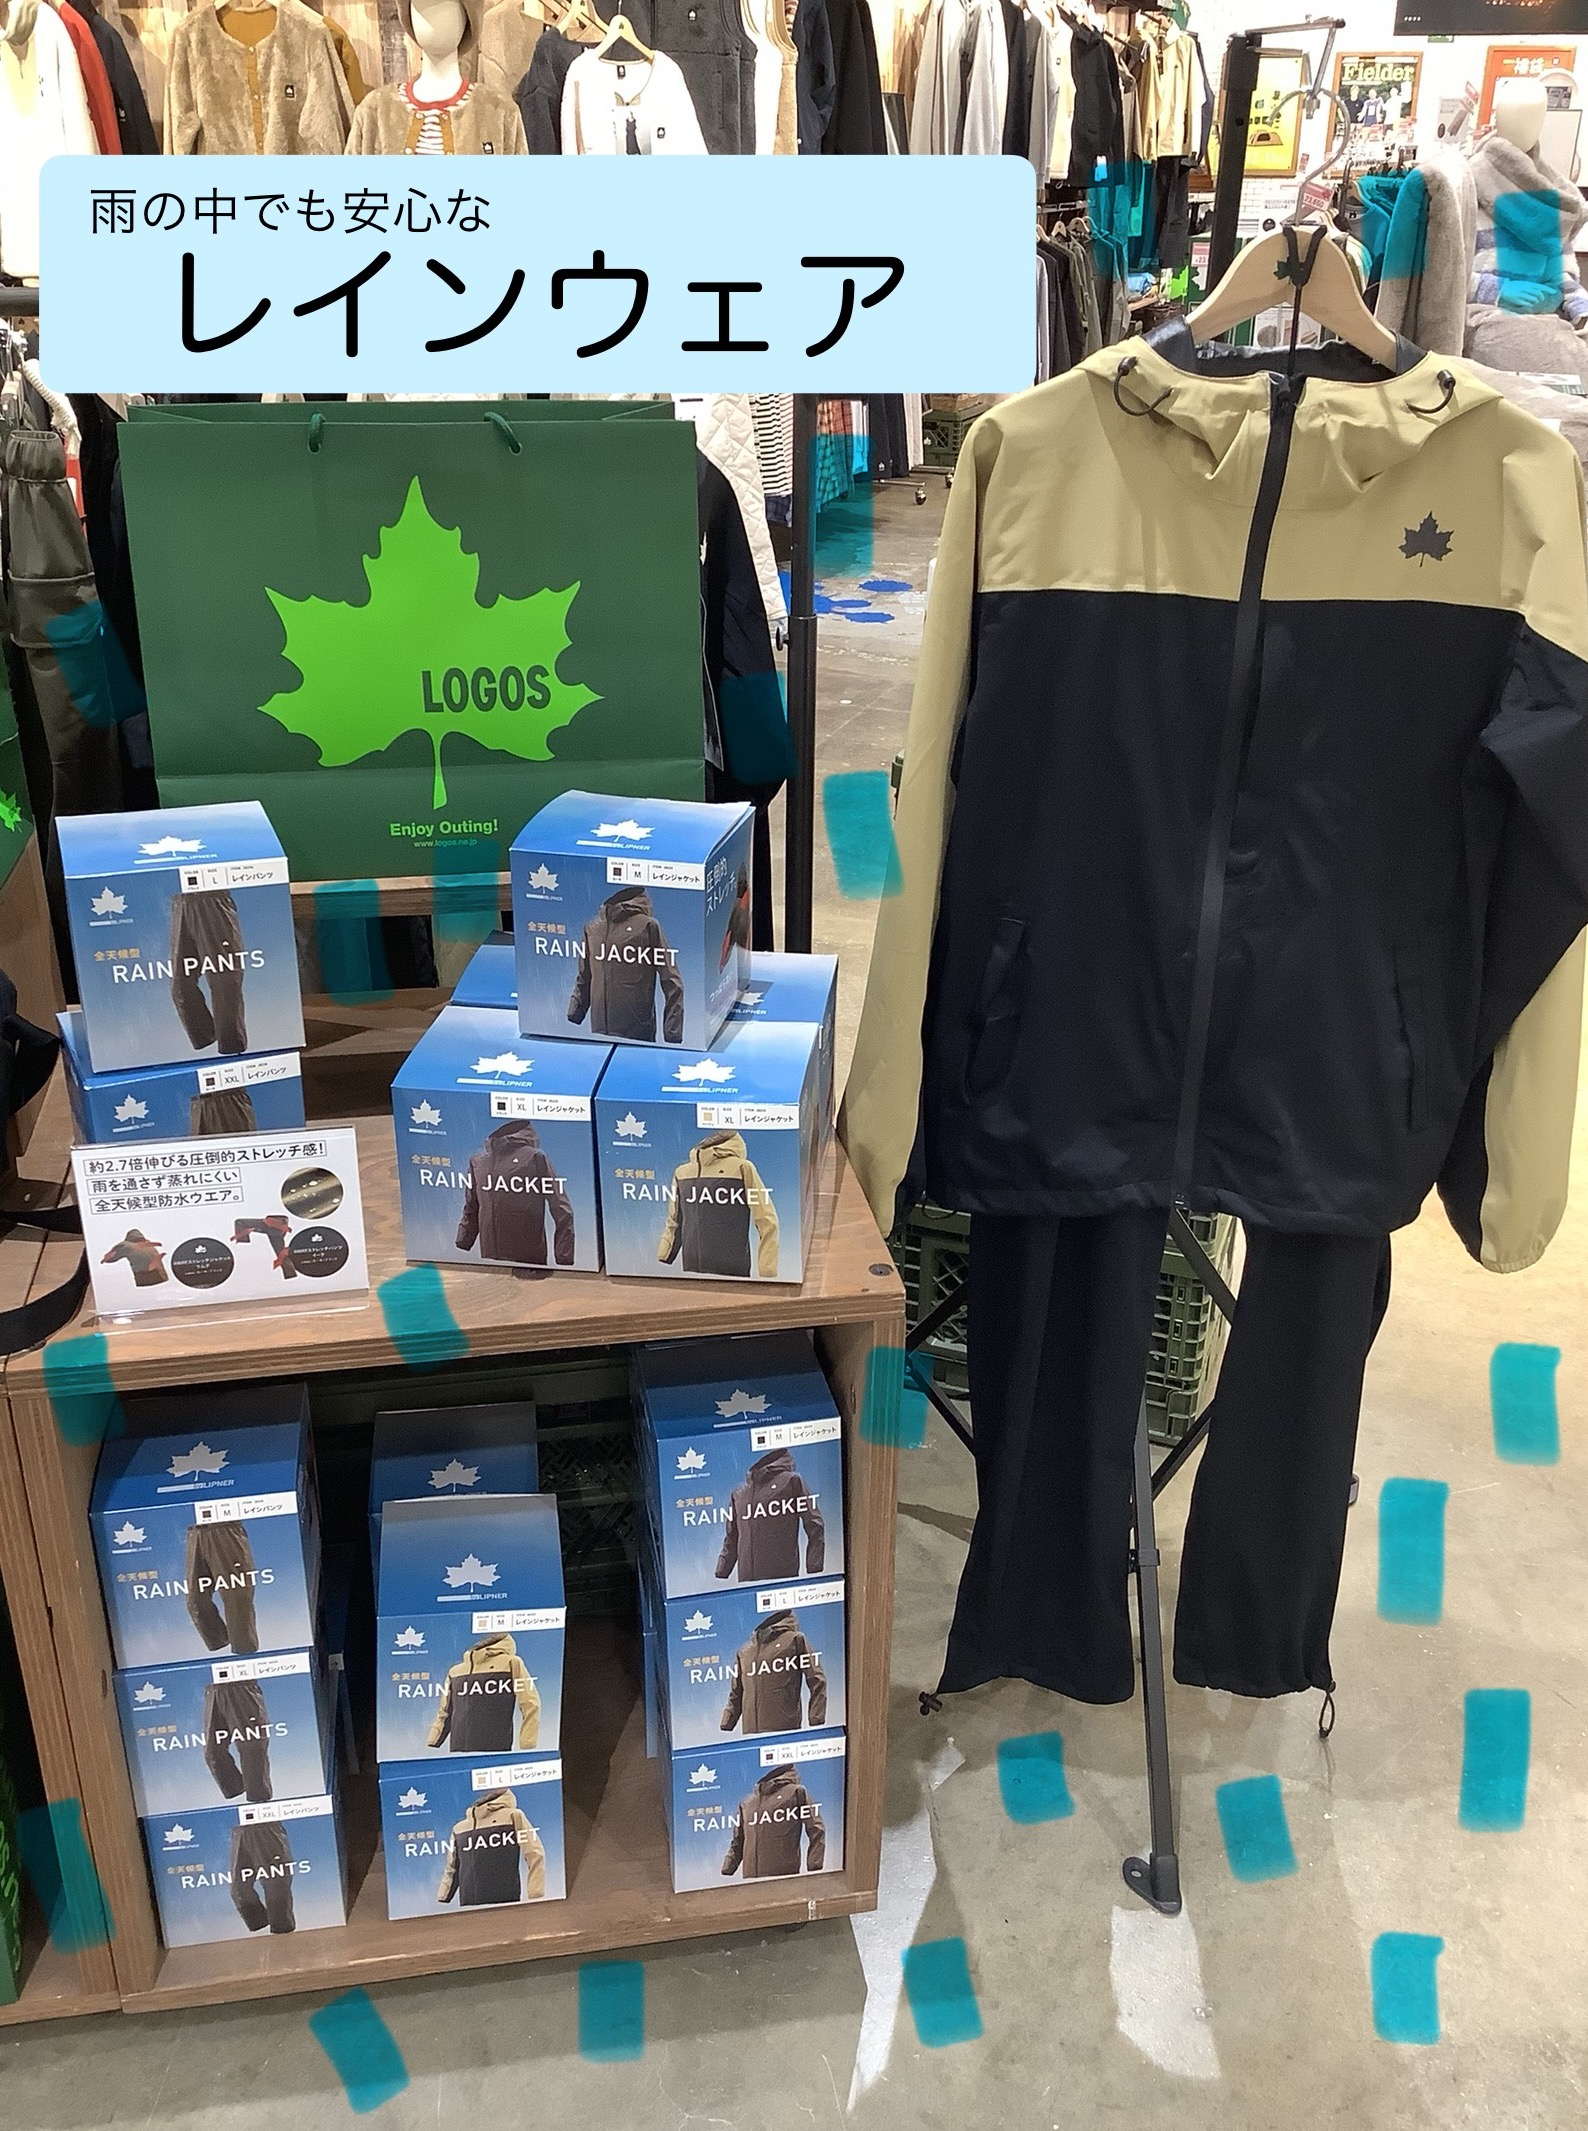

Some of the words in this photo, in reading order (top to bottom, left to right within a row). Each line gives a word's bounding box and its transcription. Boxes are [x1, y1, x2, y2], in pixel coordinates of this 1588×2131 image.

[1342, 63, 1415, 82] Fielder
[421, 664, 551, 713] LOGOS
[389, 822, 434, 838] Enjoy
[439, 819, 498, 835] Outing!
[413, 838, 478, 848] www.logos.ne.jp
[232, 872, 274, 882] レインパンツ
[652, 872, 700, 883] レインジャケット
[706, 856, 728, 894] 圧倒的
[527, 921, 566, 935] 全天候型
[94, 948, 140, 962] 全天候型
[534, 936, 587, 960] RAIN
[594, 943, 680, 967] JACKET
[112, 959, 173, 984] RAIN
[183, 950, 265, 976] PANTS
[224, 1075, 240, 1084] XXL
[247, 1067, 287, 1080] レインパンツ
[517, 1103, 527, 1111] XL
[537, 1105, 586, 1113] レインジャケット
[724, 1116, 734, 1124] XL
[744, 1114, 794, 1123] レインジャケット
[411, 1154, 451, 1167] 全天候型
[91, 1170, 238, 1194] 雨を通さず蒸れにくい
[419, 1168, 473, 1190] RAIN
[482, 1174, 568, 1195] JACKET
[614, 1168, 655, 1180] 全天候型
[95, 1189, 240, 1213] 全天候型防水ウエア。
[622, 1182, 677, 1203] RAIN
[686, 1186, 774, 1206] JACKET
[793, 1426, 837, 1439] レインジャケット
[243, 1504, 283, 1514] レインパンツ
[683, 1505, 734, 1527] RAIN
[741, 1493, 820, 1520] JACKET
[133, 1579, 189, 1601] RAIN
[198, 1568, 275, 1593] PANTS
[798, 1590, 841, 1602] レインジャケット
[515, 1616, 560, 1626] レインジャケット
[690, 1664, 739, 1684] RAIN
[746, 1651, 823, 1677] JACKET
[398, 1682, 450, 1699] RAIN
[457, 1677, 538, 1697] JACKET
[153, 1732, 207, 1752] RAIN
[215, 1722, 289, 1745] PANTS
[514, 1769, 557, 1780] レインジャケット
[693, 1814, 741, 1832] RAIN
[748, 1803, 823, 1826] JACKET
[405, 1839, 456, 1858] RAIN
[462, 1827, 541, 1851] JACKET
[181, 1871, 233, 1889] RAIN
[241, 1860, 312, 1882] PANTS
